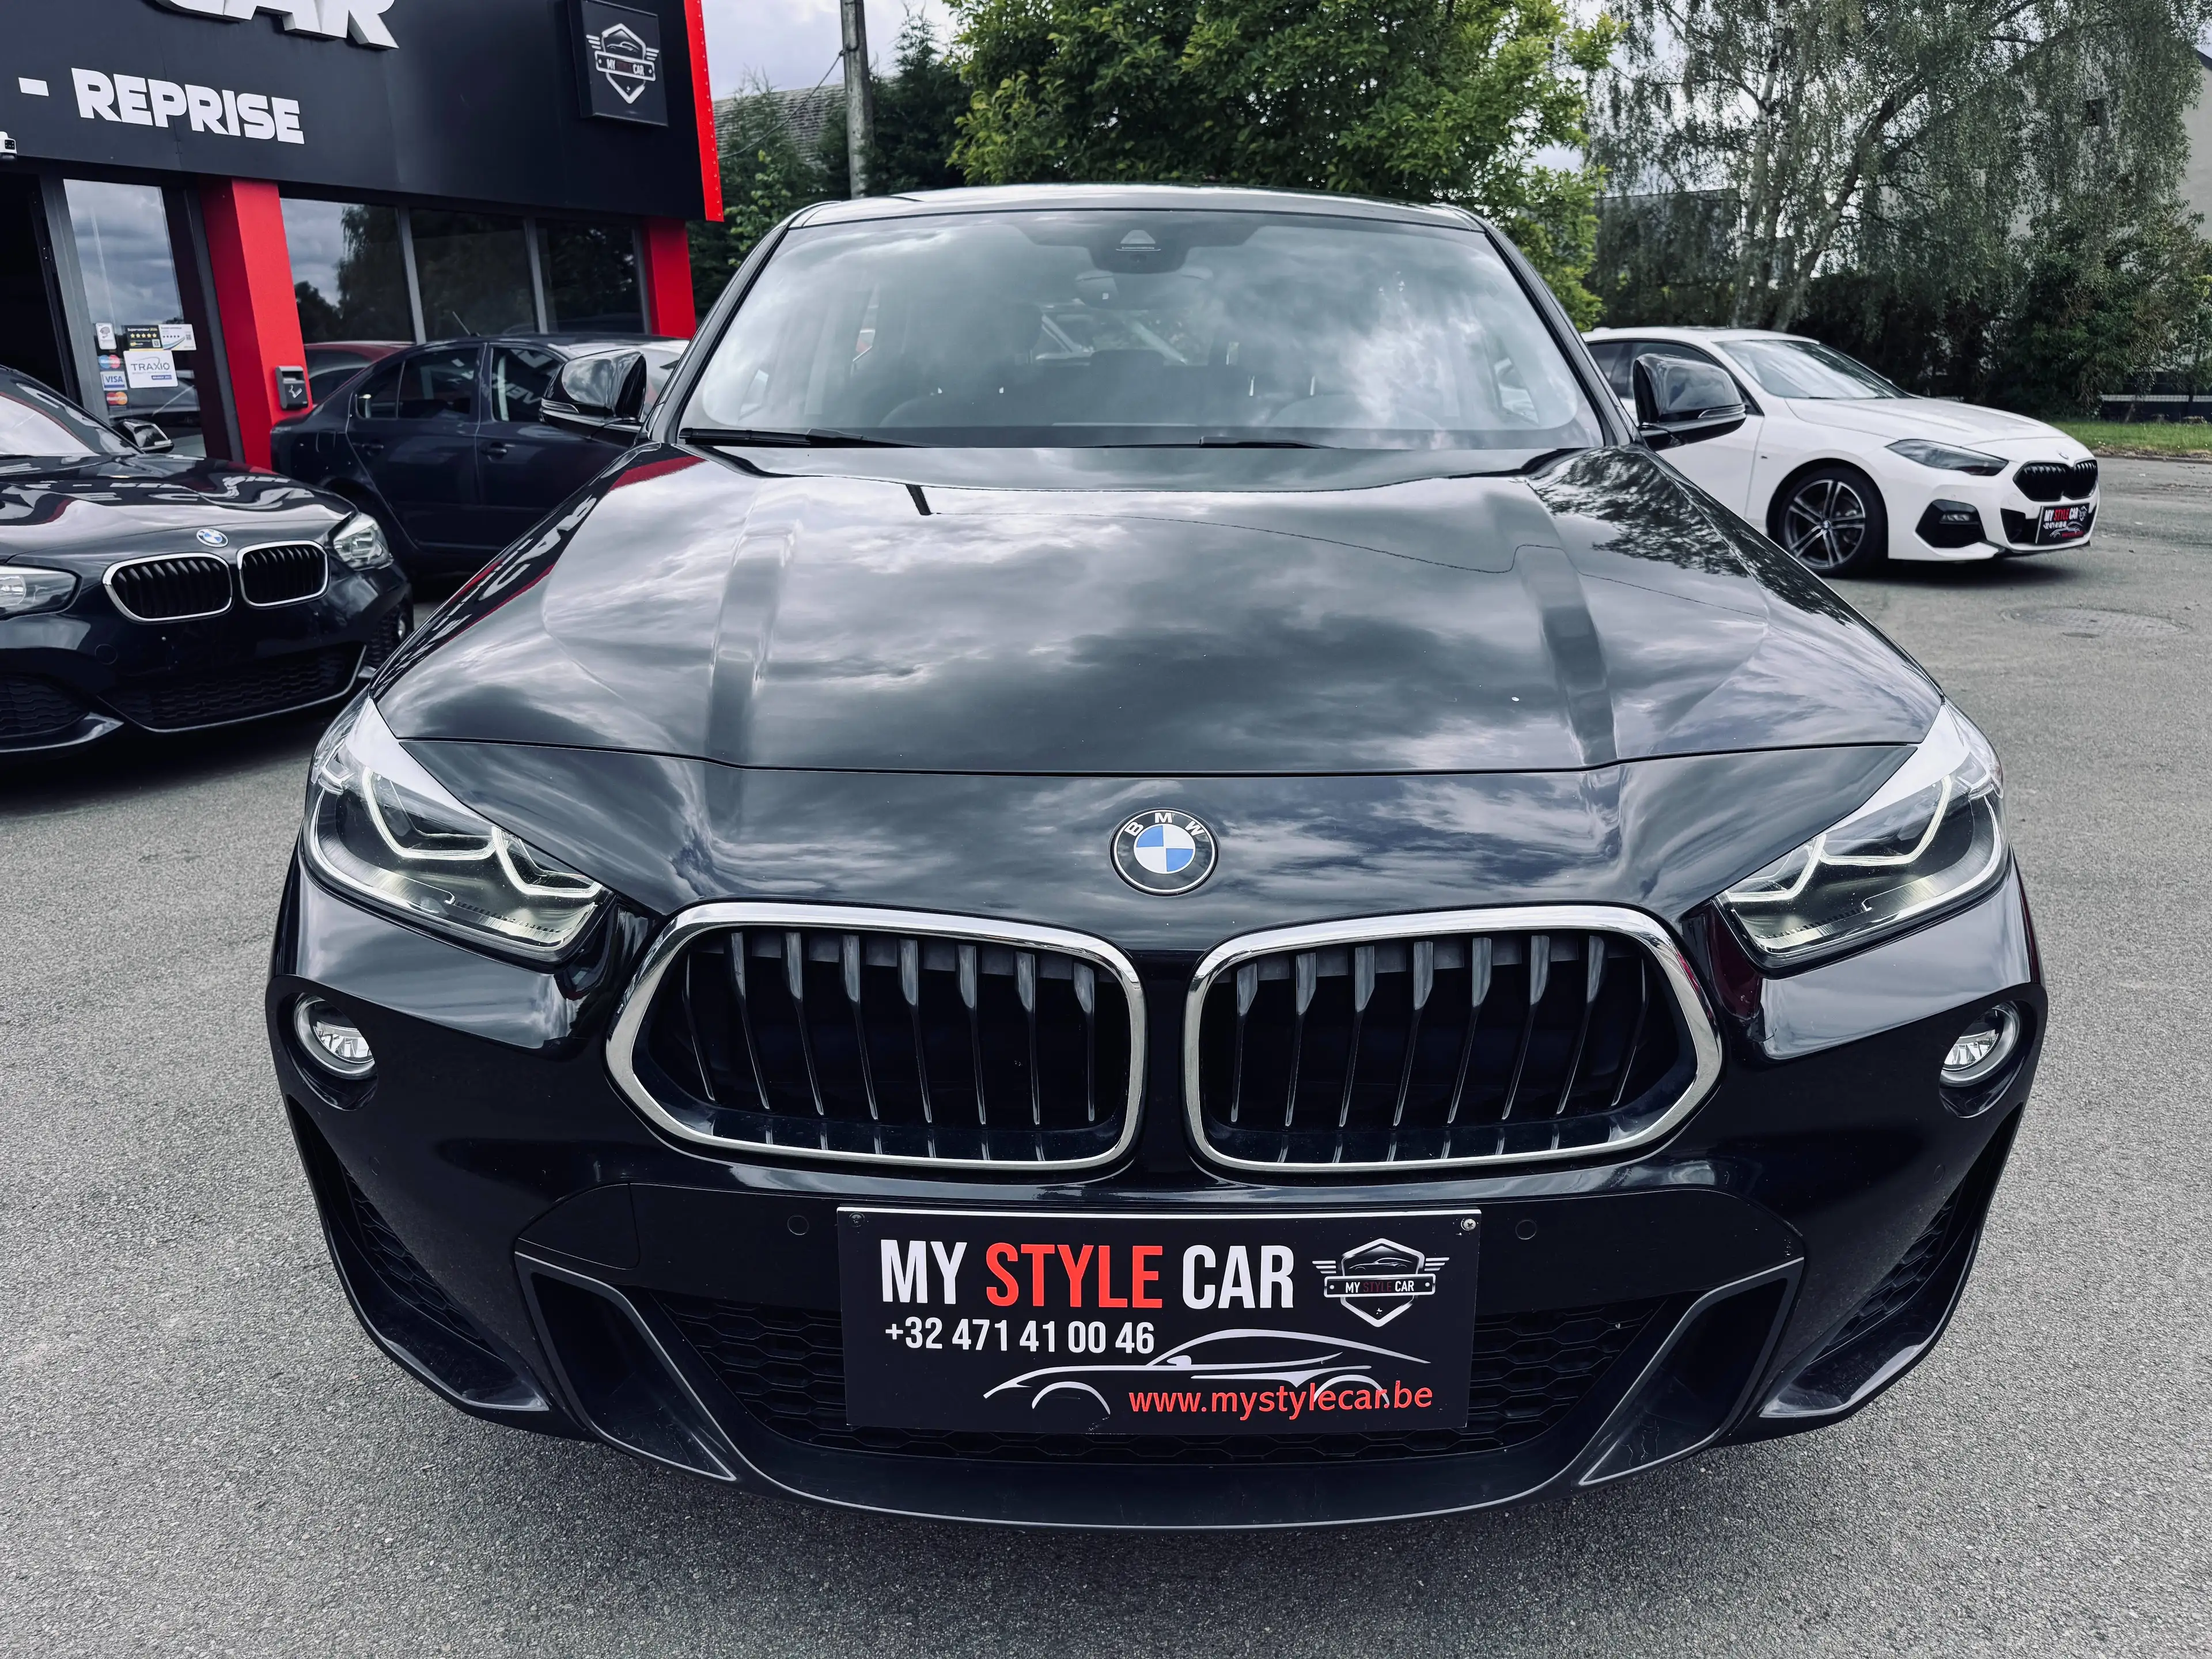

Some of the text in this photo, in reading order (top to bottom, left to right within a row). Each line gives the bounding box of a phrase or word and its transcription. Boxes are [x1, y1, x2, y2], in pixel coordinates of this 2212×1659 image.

[607, 58, 615, 70] MY
[71, 67, 305, 145] REPRISE
[131, 362, 170, 371] TRAXIO
[1124, 812, 1205, 836] BMW
[881, 1239, 1294, 1309] MY STYLE CAR
[1346, 1281, 1414, 1293] MY STYLE CAR
[885, 1316, 1154, 1354] +32 471 41 00 46
[1129, 1380, 1433, 1421] www.mystylecar.be
